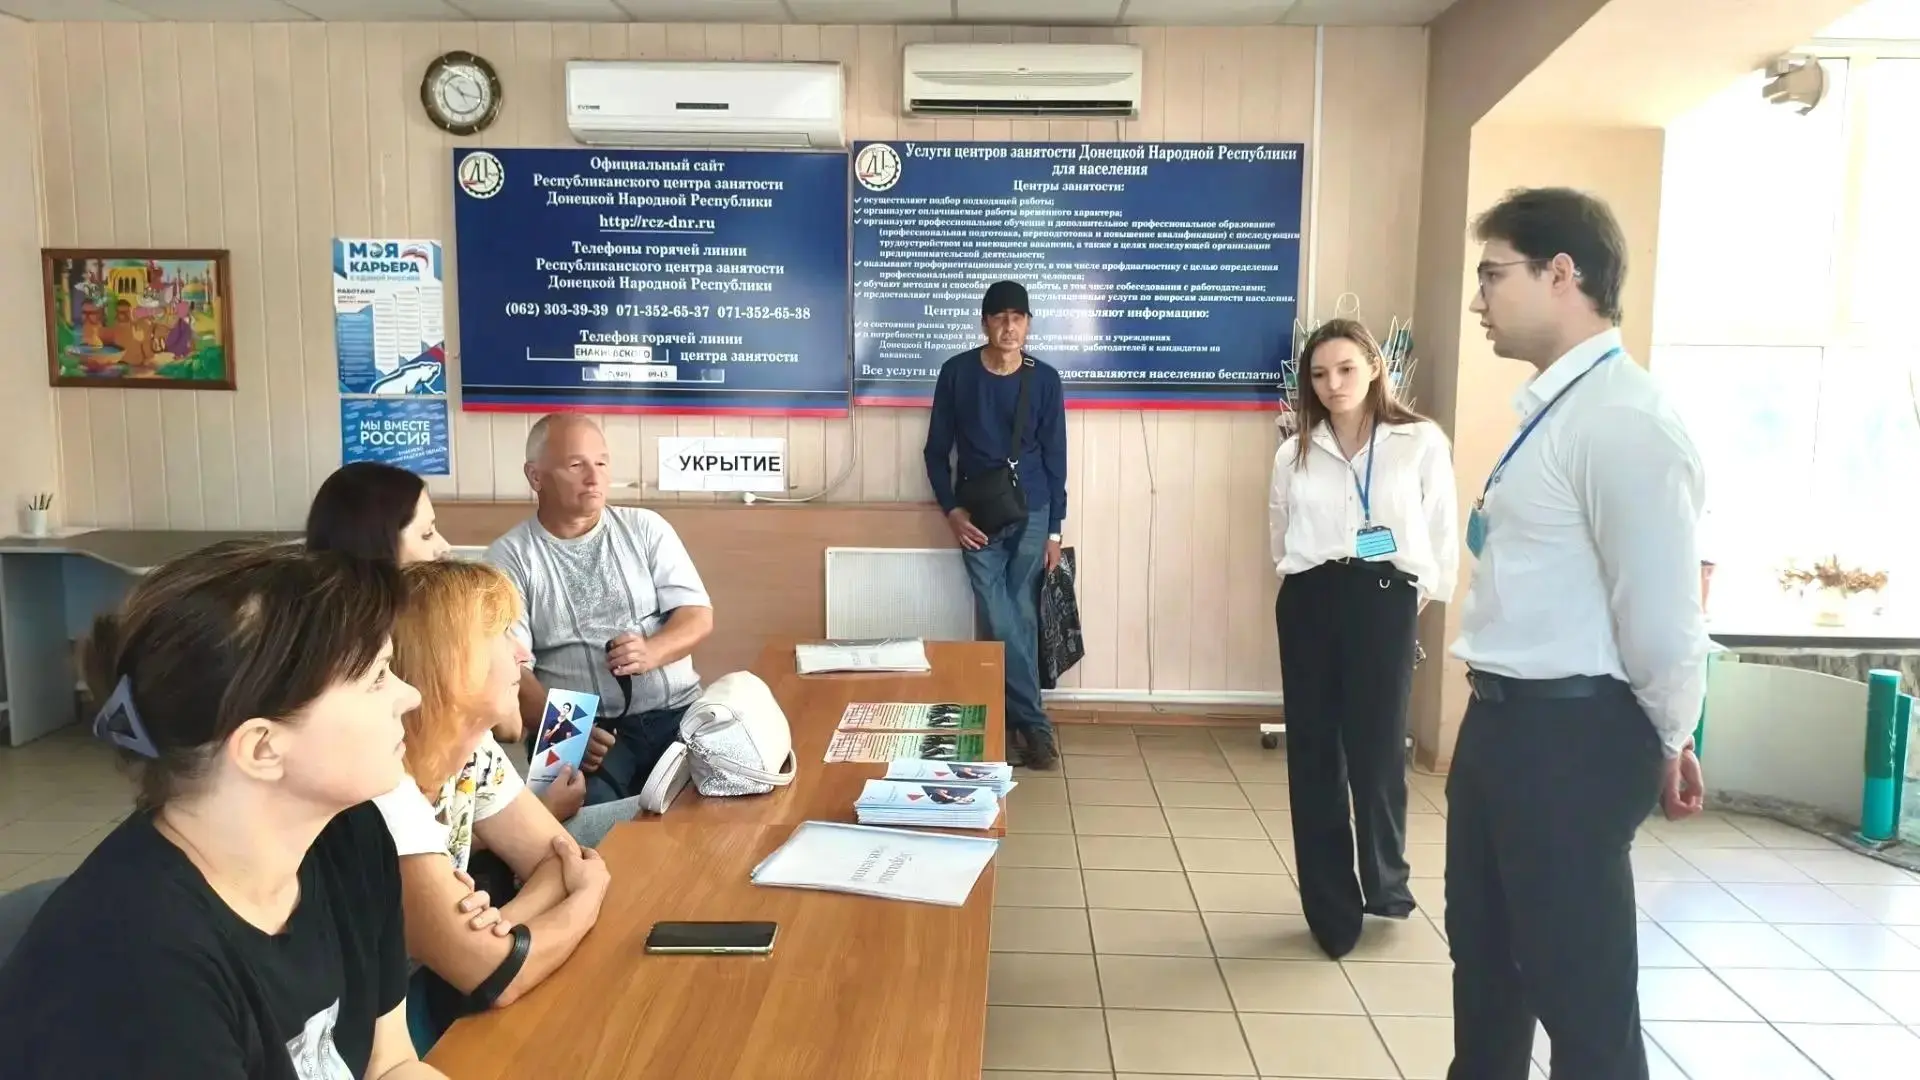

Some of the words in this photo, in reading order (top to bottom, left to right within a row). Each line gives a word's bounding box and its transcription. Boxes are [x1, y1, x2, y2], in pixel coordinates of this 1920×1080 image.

[906, 142, 950, 160] Услуги
[954, 147, 1007, 160] центров
[1010, 148, 1075, 158] занятости
[1079, 144, 1144, 161] Донецкой
[1148, 144, 1213, 162] Народной
[1218, 145, 1296, 162] Республики
[590, 156, 689, 172] Официальный
[694, 159, 725, 171] сайт
[1051, 165, 1075, 176] для
[1079, 165, 1148, 175] населения
[533, 174, 660, 190] Республиканского
[662, 179, 711, 191] центра
[714, 180, 784, 190] занятости
[1012, 179, 1059, 192] Центры
[1062, 181, 1124, 192] занятости:
[546, 191, 613, 206] Донецкой
[619, 192, 685, 207] Народной
[691, 193, 773, 209] Республики
[863, 197, 928, 205] осуществляют
[928, 196, 961, 206] подбор
[962, 197, 1017, 205] подходящей
[1018, 197, 1054, 206] работы;
[863, 208, 916, 216] организуют
[985, 207, 1016, 217] работы
[1019, 209, 1071, 217] временного
[1074, 210, 1122, 218] характера;
[599, 214, 716, 231] http://rcz-dnr.ru
[918, 217, 1002, 227] профессиональное
[1003, 218, 1045, 227] обучение
[1054, 220, 1128, 228] дополнительное
[1131, 219, 1216, 229] профессиональное
[1218, 219, 1275, 229] образование
[878, 227, 966, 237] (профессиональная
[1022, 231, 1093, 239] переподготовка
[1156, 230, 1227, 240] квалификации)
[1236, 231, 1300, 240] последующим
[349, 243, 399, 258] МОЯ
[572, 240, 641, 257] Телефоны
[646, 242, 698, 258] горячей
[703, 246, 747, 256] линии
[878, 239, 961, 248] трудоустройством
[1148, 241, 1210, 250] последующей
[1211, 243, 1271, 251] организации
[879, 249, 980, 258] предпринимательской
[350, 262, 419, 272] КАРЬЕРА
[536, 258, 662, 274] Республиканского
[664, 263, 713, 275] центра
[715, 264, 784, 274] занятости
[913, 260, 1012, 270] профориентационные
[1012, 262, 1047, 270] услуги,
[1101, 261, 1181, 272] профдиагностику
[1219, 264, 1279, 272] определения
[879, 270, 964, 280] профессиональной
[964, 272, 1039, 281] направленности
[548, 275, 614, 289] Донецкой
[620, 276, 686, 291] Народной
[692, 277, 773, 293] Республики
[505, 302, 540, 316] (062)
[543, 303, 609, 315] 303-39-39
[615, 304, 711, 317] 071-352-65-37
[716, 306, 811, 319] 071-352-65-38
[924, 304, 970, 318] Центры
[1126, 306, 1209, 320] информацию:
[580, 329, 639, 345] Телефон
[640, 334, 696, 346] горячей
[698, 335, 742, 344] линии
[879, 340, 922, 349] Донецкой
[924, 341, 967, 350] Народной
[680, 350, 728, 363] центра
[729, 352, 799, 362] занятости
[862, 364, 883, 375] Все
[886, 367, 926, 377] услуги
[1058, 370, 1146, 380] едоставляются
[1148, 370, 1216, 378] населению
[1217, 369, 1281, 379] бесплатно
[361, 421, 380, 431] МЫ
[384, 421, 430, 431] ВМЕСТЕ
[361, 431, 431, 445] РОССИЯ
[680, 455, 780, 471] УКРЫТИЕ
